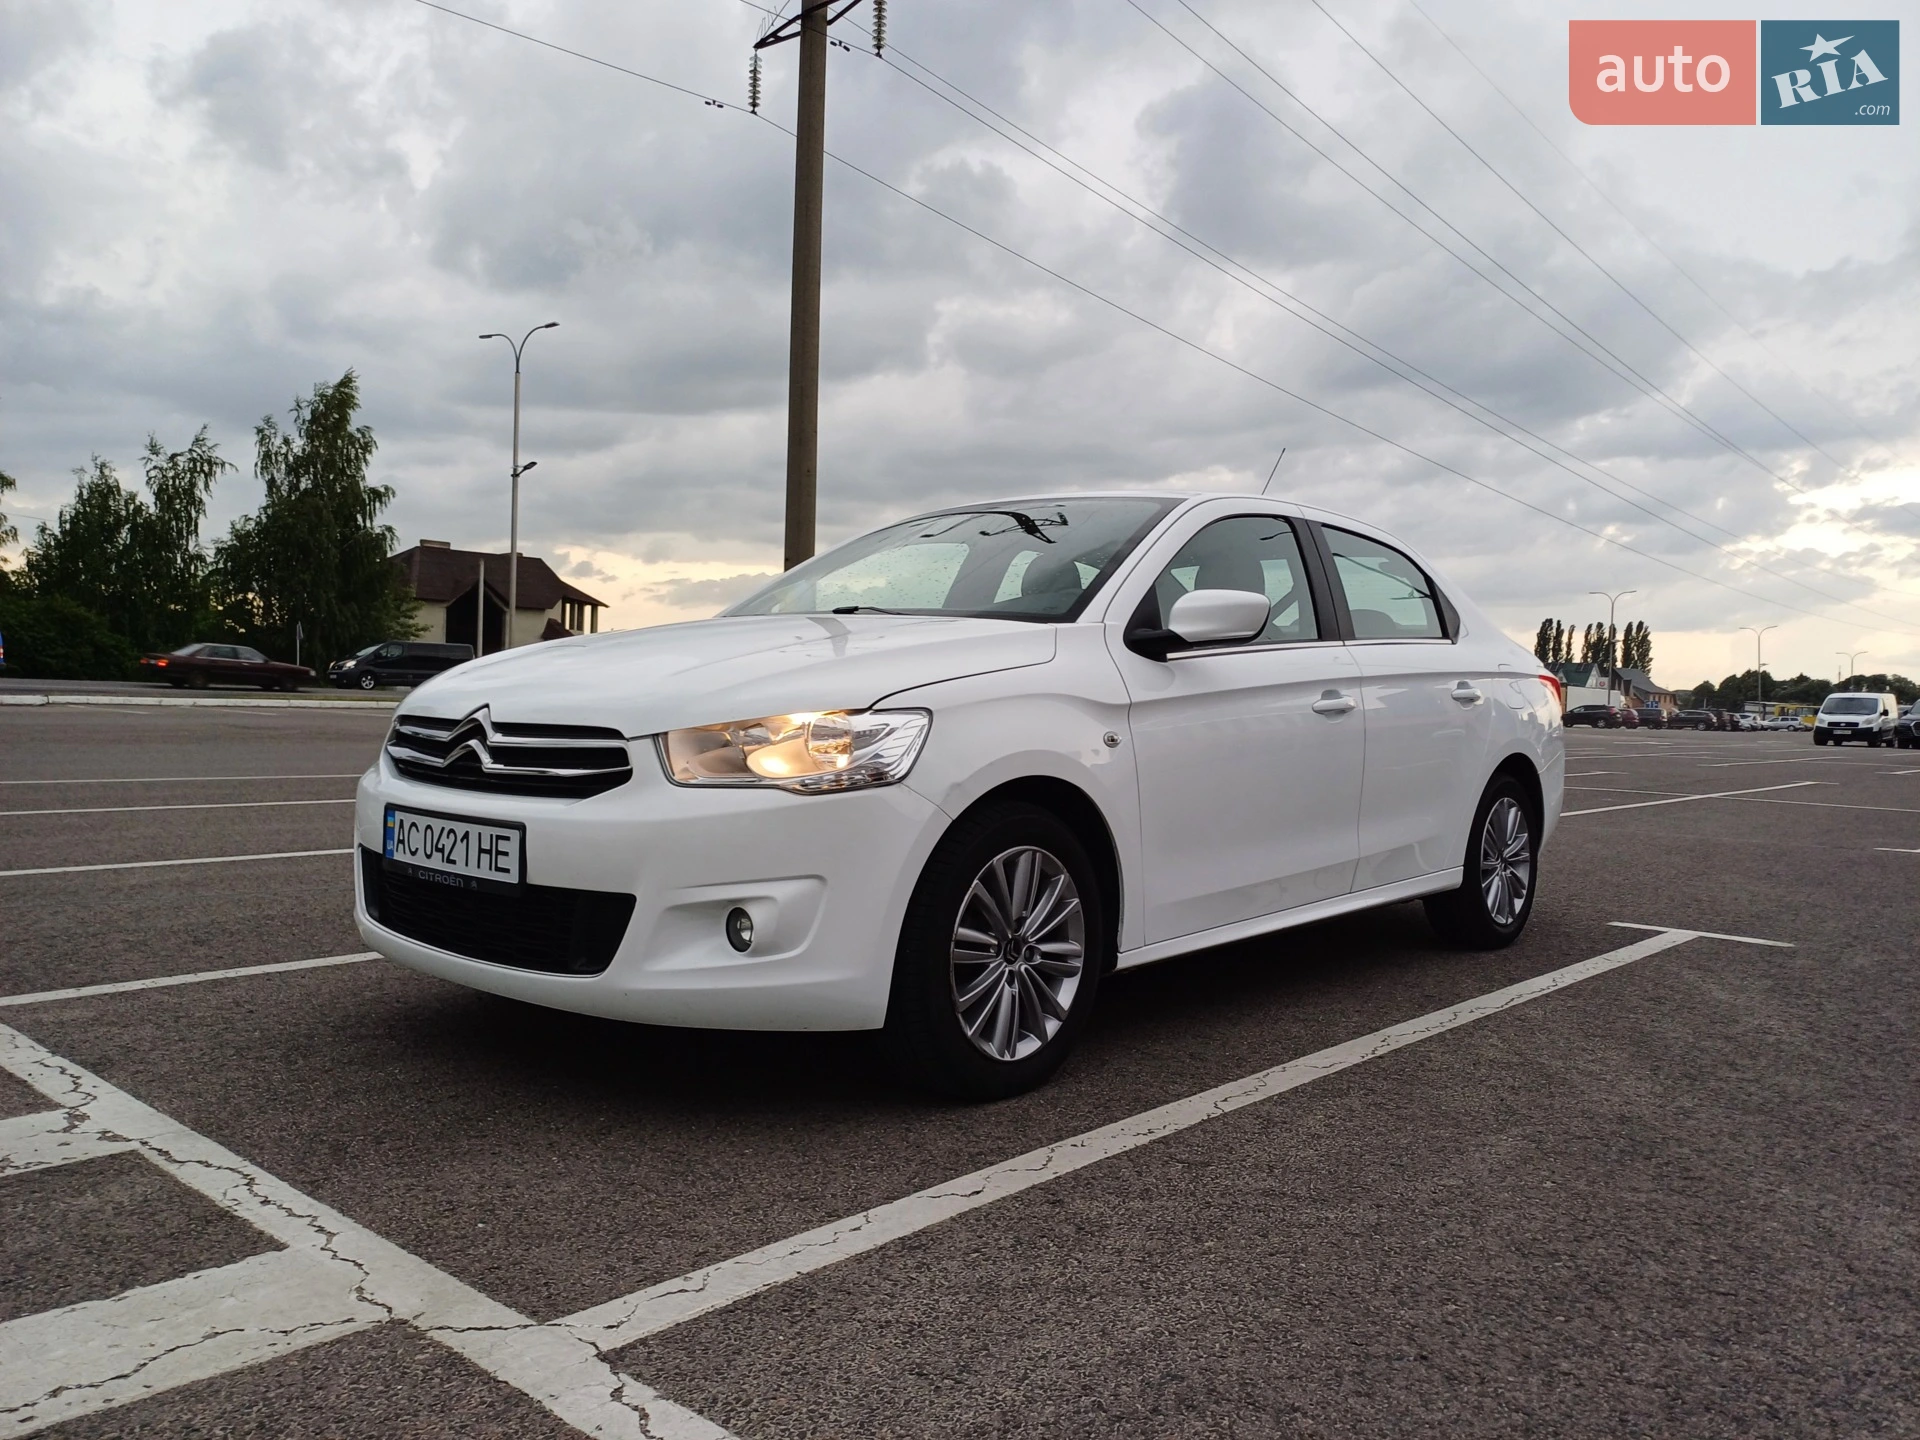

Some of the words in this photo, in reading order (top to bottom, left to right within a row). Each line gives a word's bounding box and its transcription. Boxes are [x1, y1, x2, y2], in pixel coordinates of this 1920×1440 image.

[395, 818, 420, 857] AC
[423, 824, 470, 867] 0421
[477, 831, 511, 874] HE
